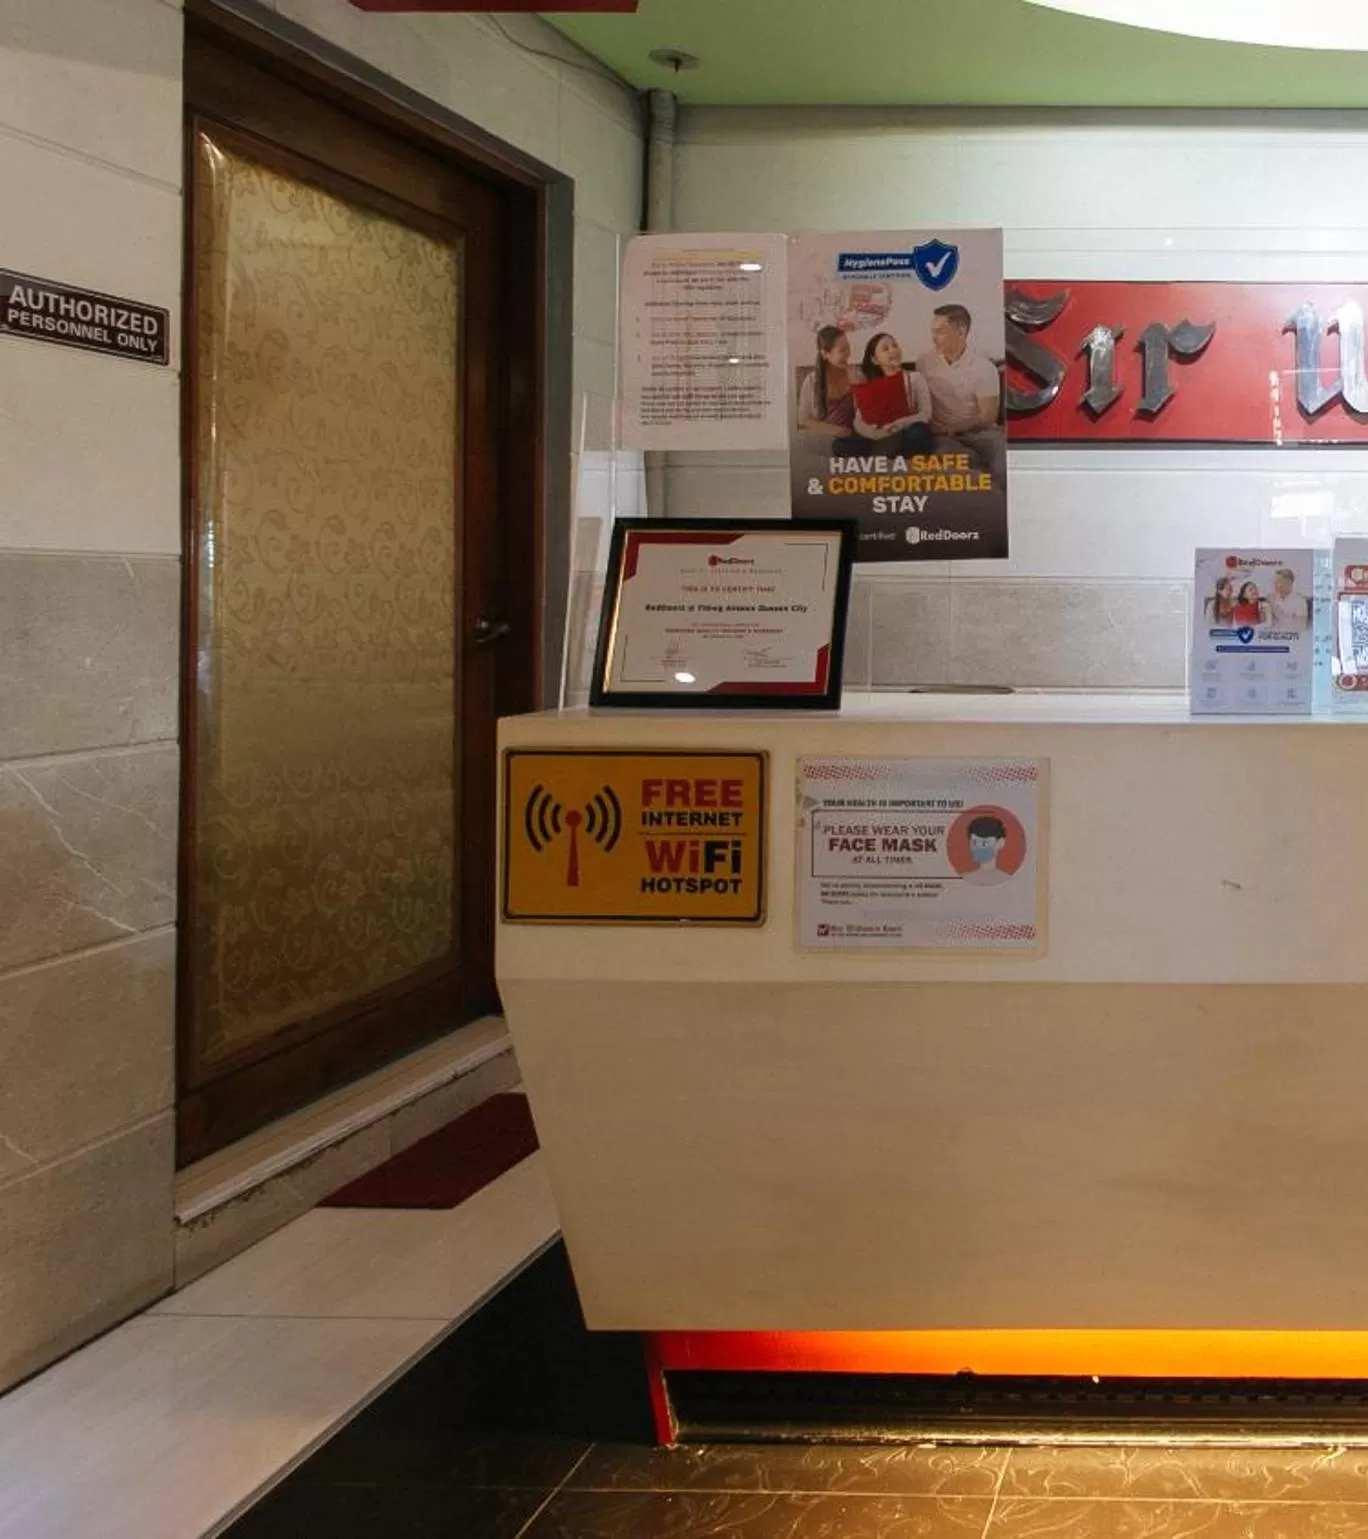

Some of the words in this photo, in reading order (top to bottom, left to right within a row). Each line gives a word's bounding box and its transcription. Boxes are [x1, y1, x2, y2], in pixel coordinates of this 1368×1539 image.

[9, 284, 158, 335] AUTHORIZED
[8, 309, 112, 343] PERSONNEL
[117, 333, 158, 353] ONLY
[829, 456, 887, 474] HAVE
[892, 455, 909, 473] A
[910, 453, 970, 472] SAFE
[807, 477, 824, 495] &
[828, 473, 992, 495] COMFORTABLE
[872, 495, 929, 513] STAY
[919, 529, 980, 541] RedDoorz
[641, 778, 744, 808] FREE
[846, 799, 876, 808] HEALTH
[889, 800, 935, 808] IMPORTANT
[936, 800, 947, 808] TO
[641, 811, 744, 827] INTERNET
[823, 825, 869, 836] PLEASE
[871, 825, 910, 836] WEAR
[912, 825, 945, 836] YOUR
[828, 838, 876, 853] FACE
[881, 838, 937, 853] MASK
[645, 839, 742, 874] WiFi
[852, 856, 862, 864] AT
[865, 856, 881, 864] ALL
[641, 877, 743, 894] HOTSPOT
